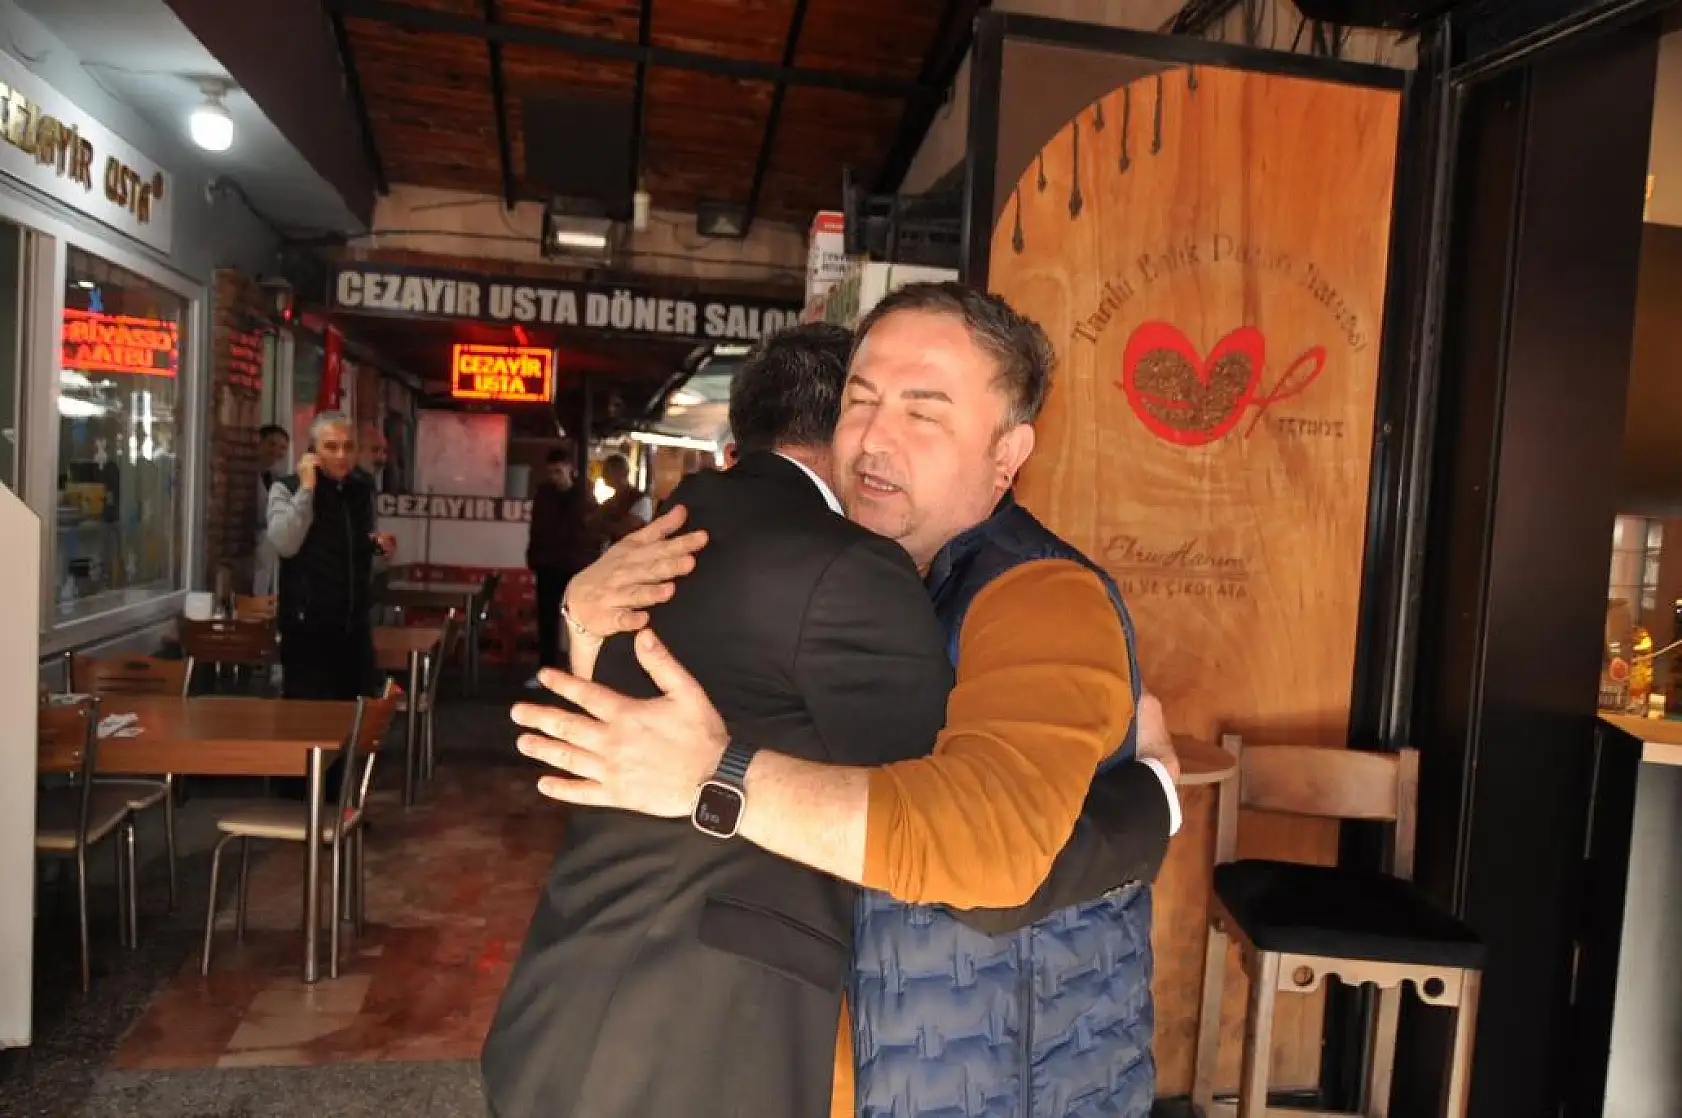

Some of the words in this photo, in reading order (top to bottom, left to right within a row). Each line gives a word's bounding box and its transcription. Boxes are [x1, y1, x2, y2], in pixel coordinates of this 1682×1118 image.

[105, 155, 152, 224] USTA
[339, 271, 481, 316] CEZAYİR
[489, 284, 578, 325] USTA
[586, 289, 697, 334] DÖNER
[460, 354, 542, 378] CEZAYİR
[475, 376, 526, 393] USTA
